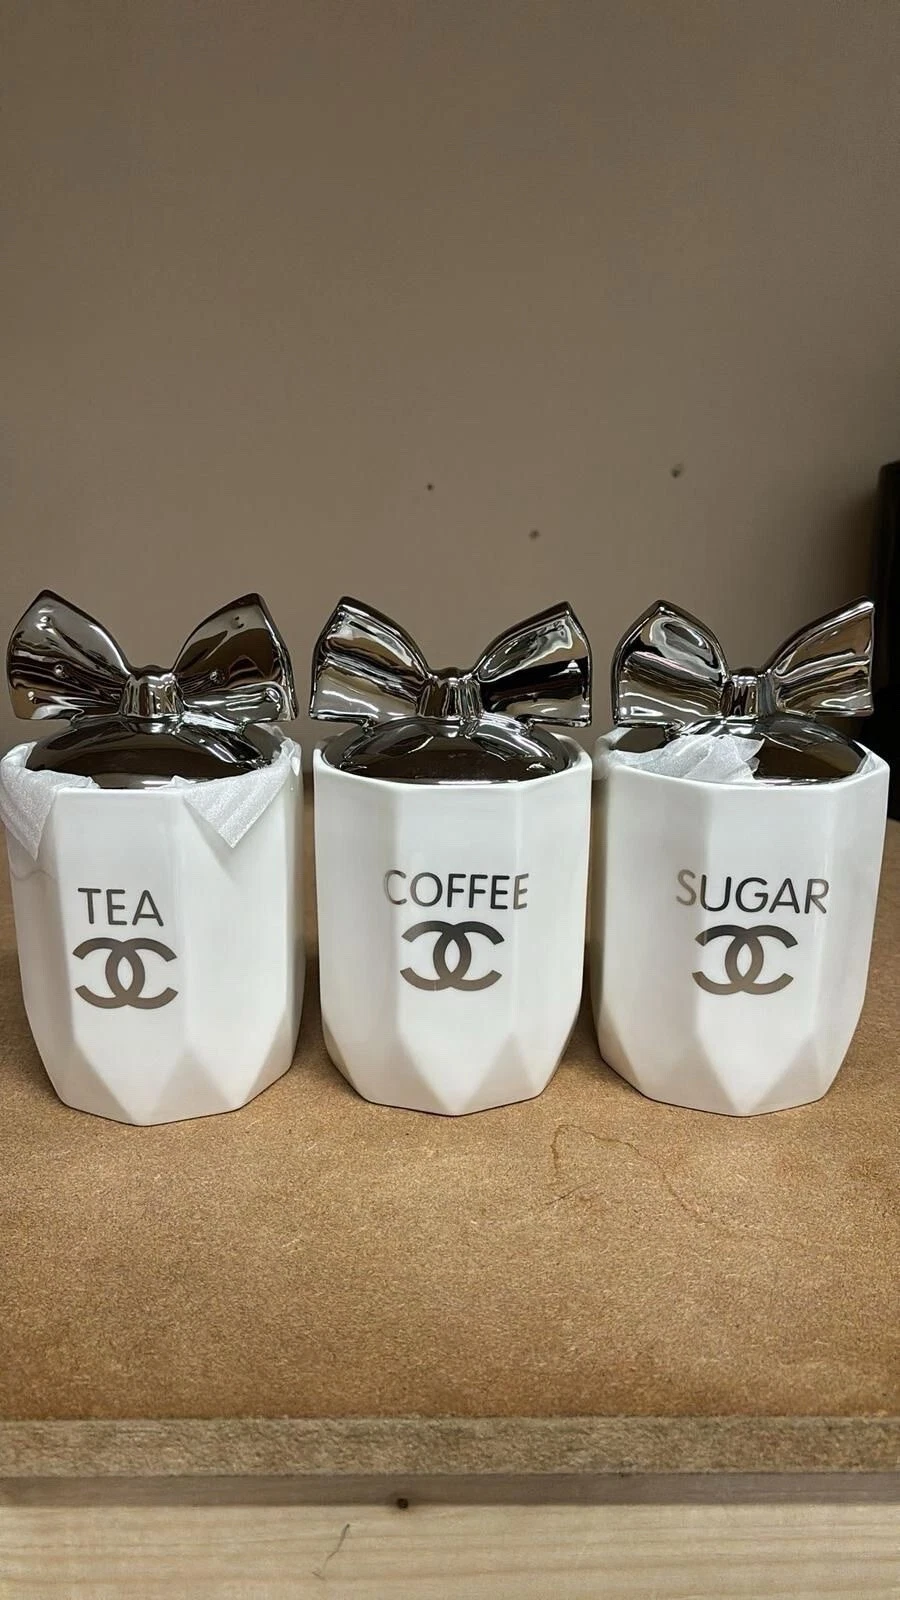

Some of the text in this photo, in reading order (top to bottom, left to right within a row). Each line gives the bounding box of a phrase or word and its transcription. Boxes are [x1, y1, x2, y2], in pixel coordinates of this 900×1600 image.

[77, 887, 165, 927] TEA
[383, 869, 530, 911] COFFEE
[675, 869, 830, 915] SUGAR
